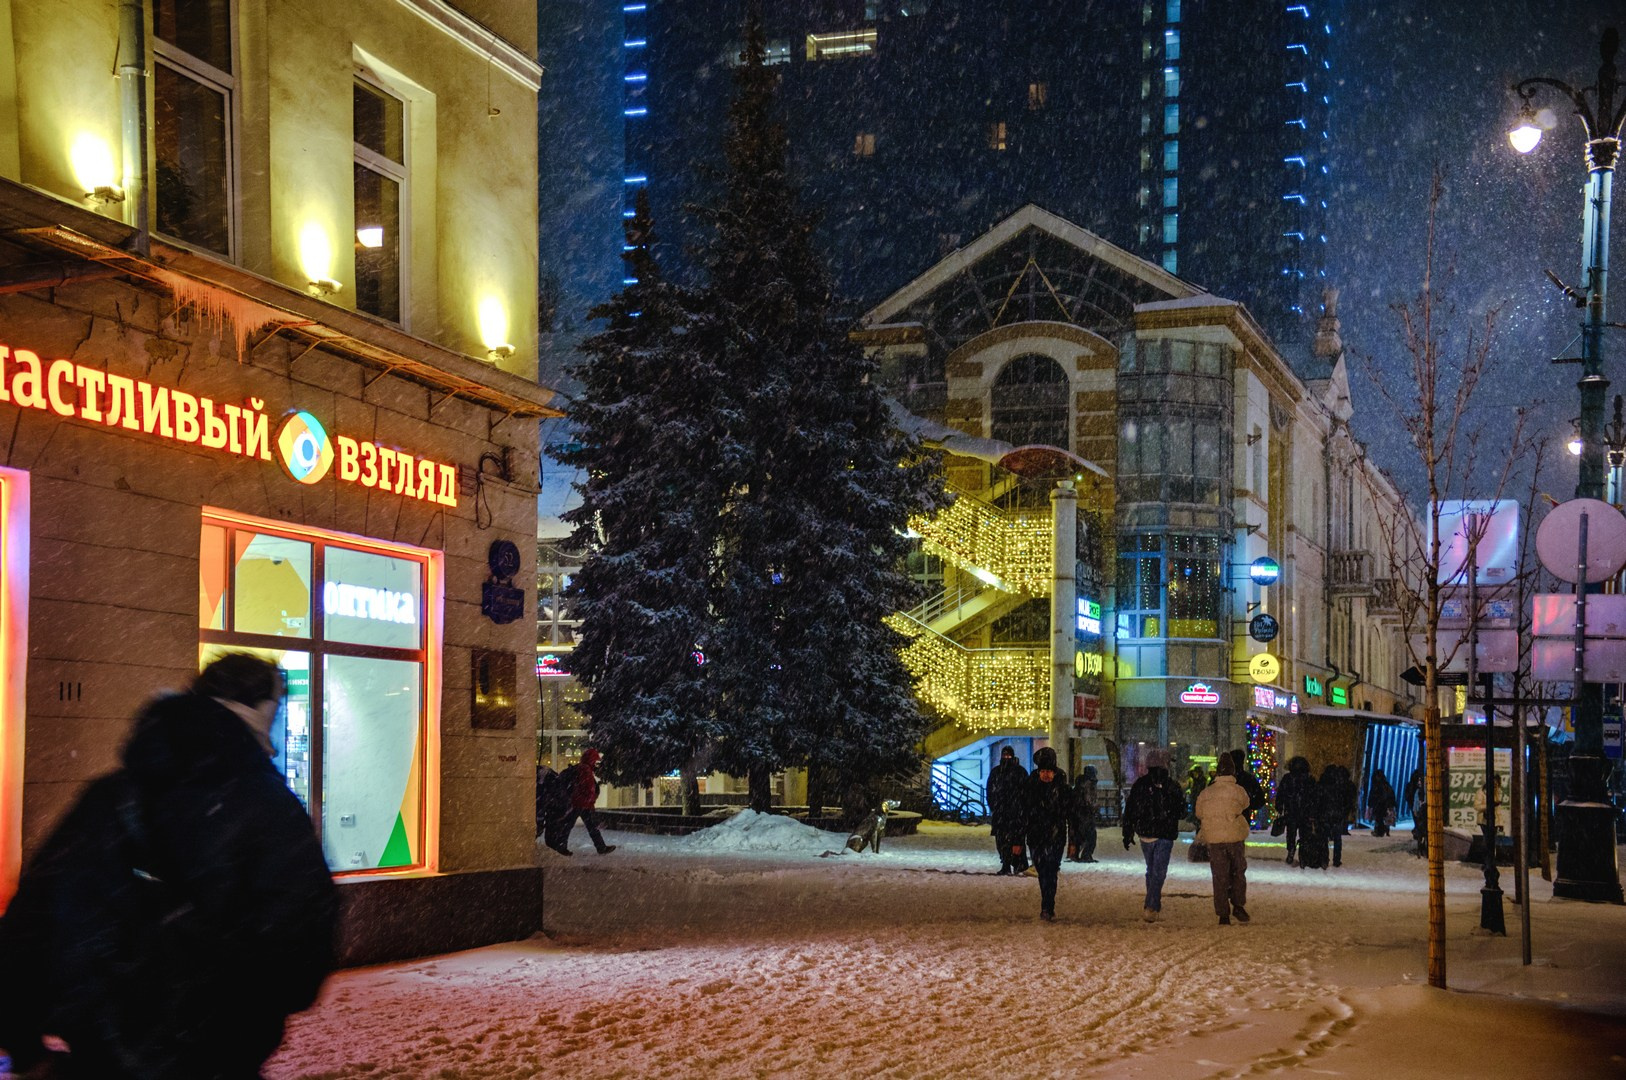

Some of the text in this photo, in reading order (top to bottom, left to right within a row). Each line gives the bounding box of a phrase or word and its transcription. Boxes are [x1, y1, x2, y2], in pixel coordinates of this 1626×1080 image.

[336, 435, 458, 507] взгляд
[504, 552, 514, 567] 52
[324, 581, 416, 624] оптика
[1450, 772, 1510, 788] ВРЕЯ
